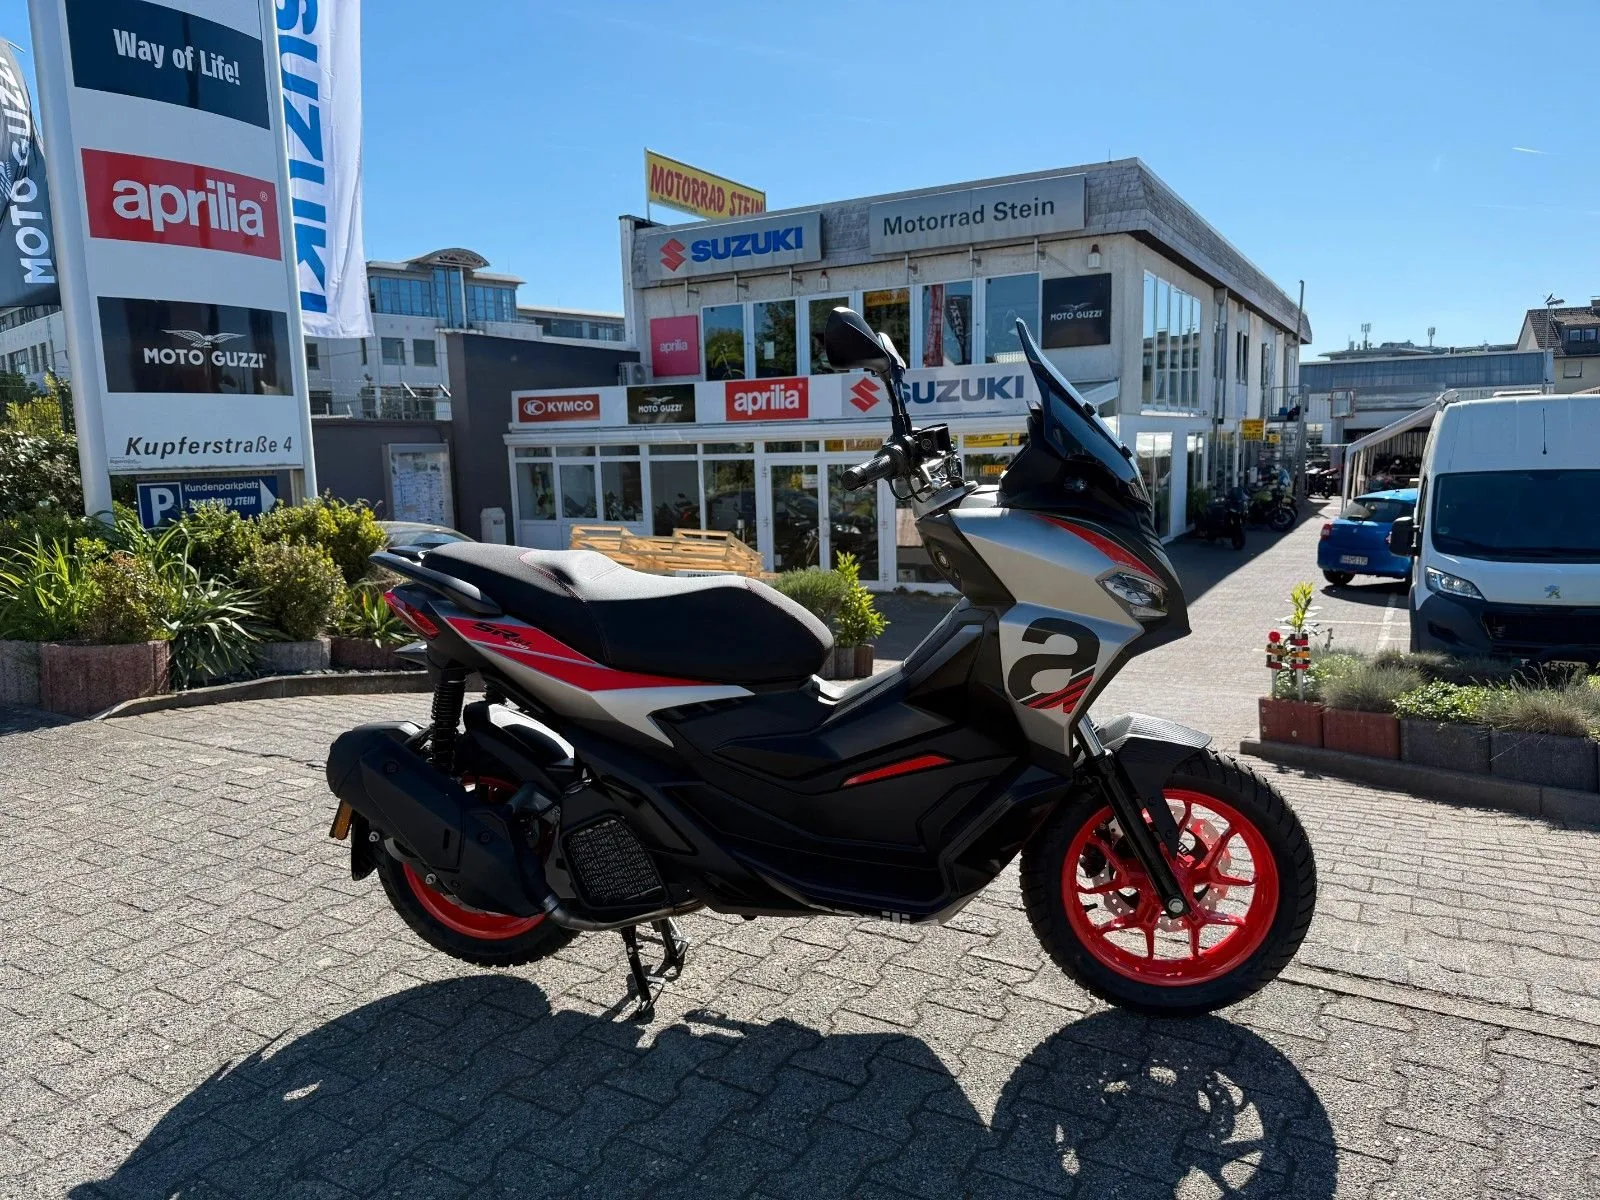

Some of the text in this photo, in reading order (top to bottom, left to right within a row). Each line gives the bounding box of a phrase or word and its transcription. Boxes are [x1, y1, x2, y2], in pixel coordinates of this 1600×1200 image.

[113, 28, 241, 86] Way of Life!
[650, 163, 726, 213] MOTORRAD
[728, 191, 764, 217] STEIN
[112, 178, 265, 239] aprilia
[883, 196, 1055, 237] Motorrad Stein
[9, 176, 57, 284] MOTO
[691, 226, 803, 263] SUZUKI
[1050, 309, 1102, 321] MOTO GUZZI
[143, 347, 264, 369] MOTO GUZZI
[659, 339, 688, 355] aprilia
[547, 400, 594, 413] KYMCO
[638, 404, 682, 414] MOTO GUZZI
[734, 384, 799, 413] aprilia
[125, 436, 293, 459] Kupferstraße 4
[184, 481, 259, 492] Kundenparkplatz
[234, 495, 256, 506] STEIN
